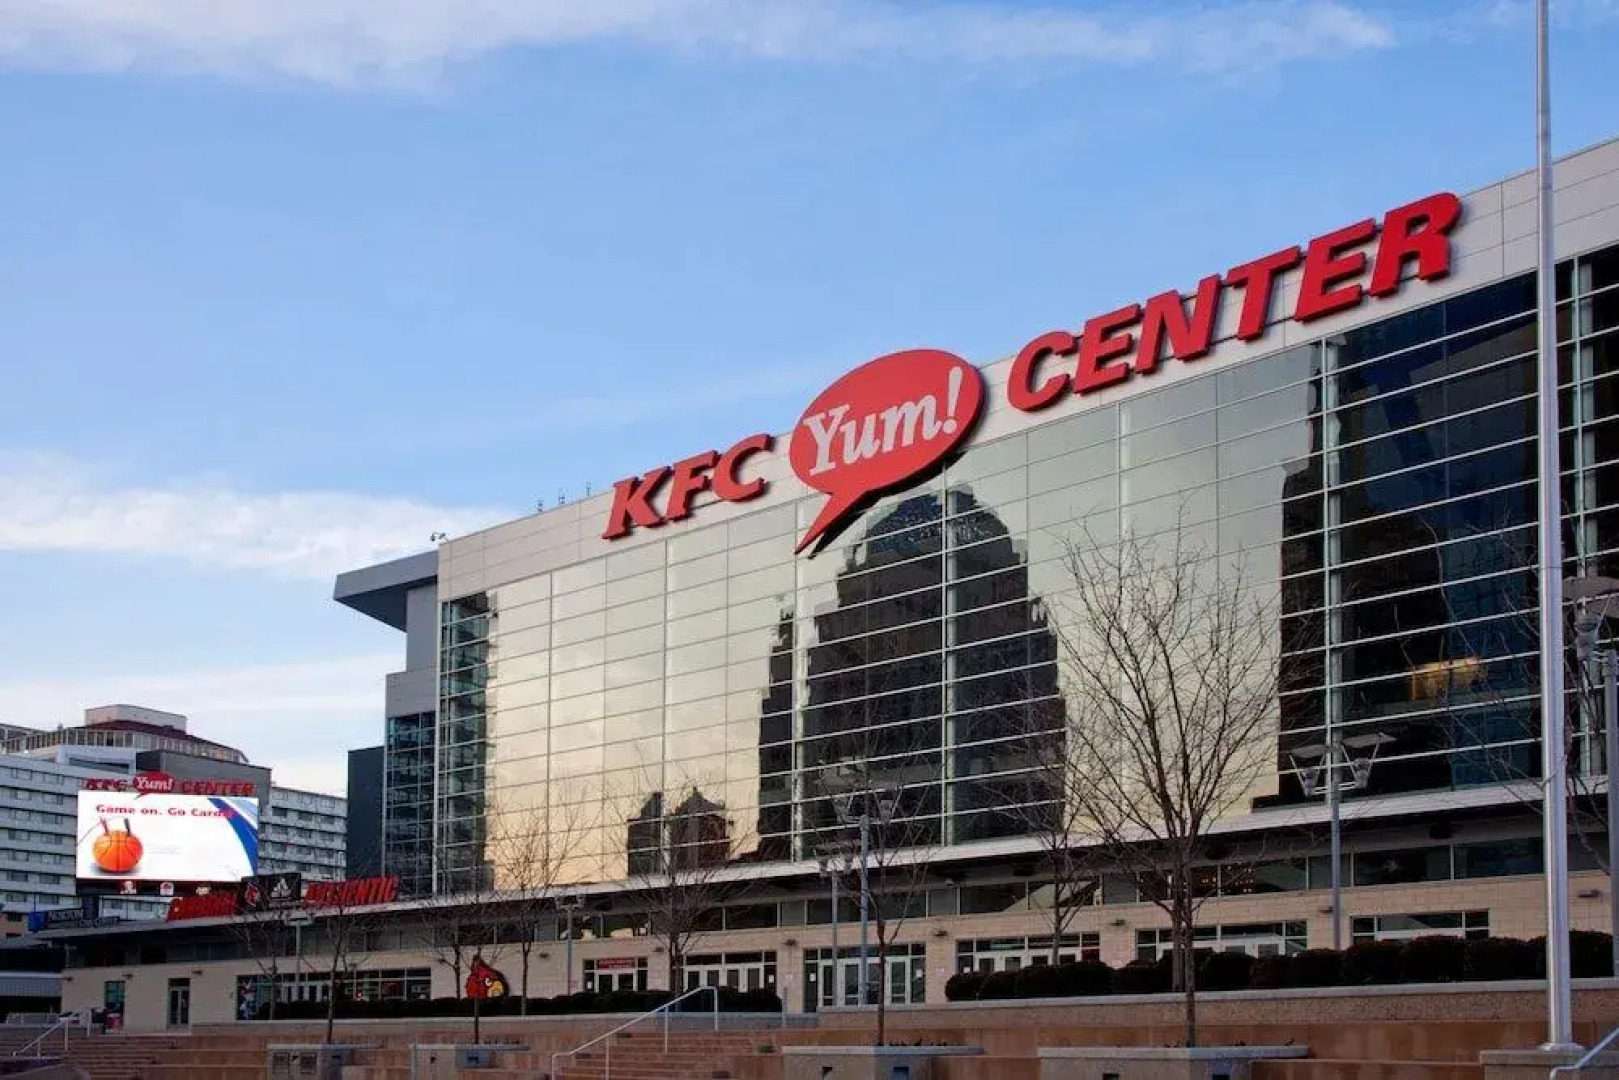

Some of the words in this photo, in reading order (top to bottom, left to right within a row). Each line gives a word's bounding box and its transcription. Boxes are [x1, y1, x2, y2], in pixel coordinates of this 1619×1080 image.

[602, 434, 775, 540] KFC
[803, 366, 962, 476] Yum!
[1007, 192, 1462, 411] CENTER
[136, 777, 173, 790] Yum!
[96, 804, 136, 814] Game
[141, 807, 162, 815] on.
[168, 808, 186, 816] Go
